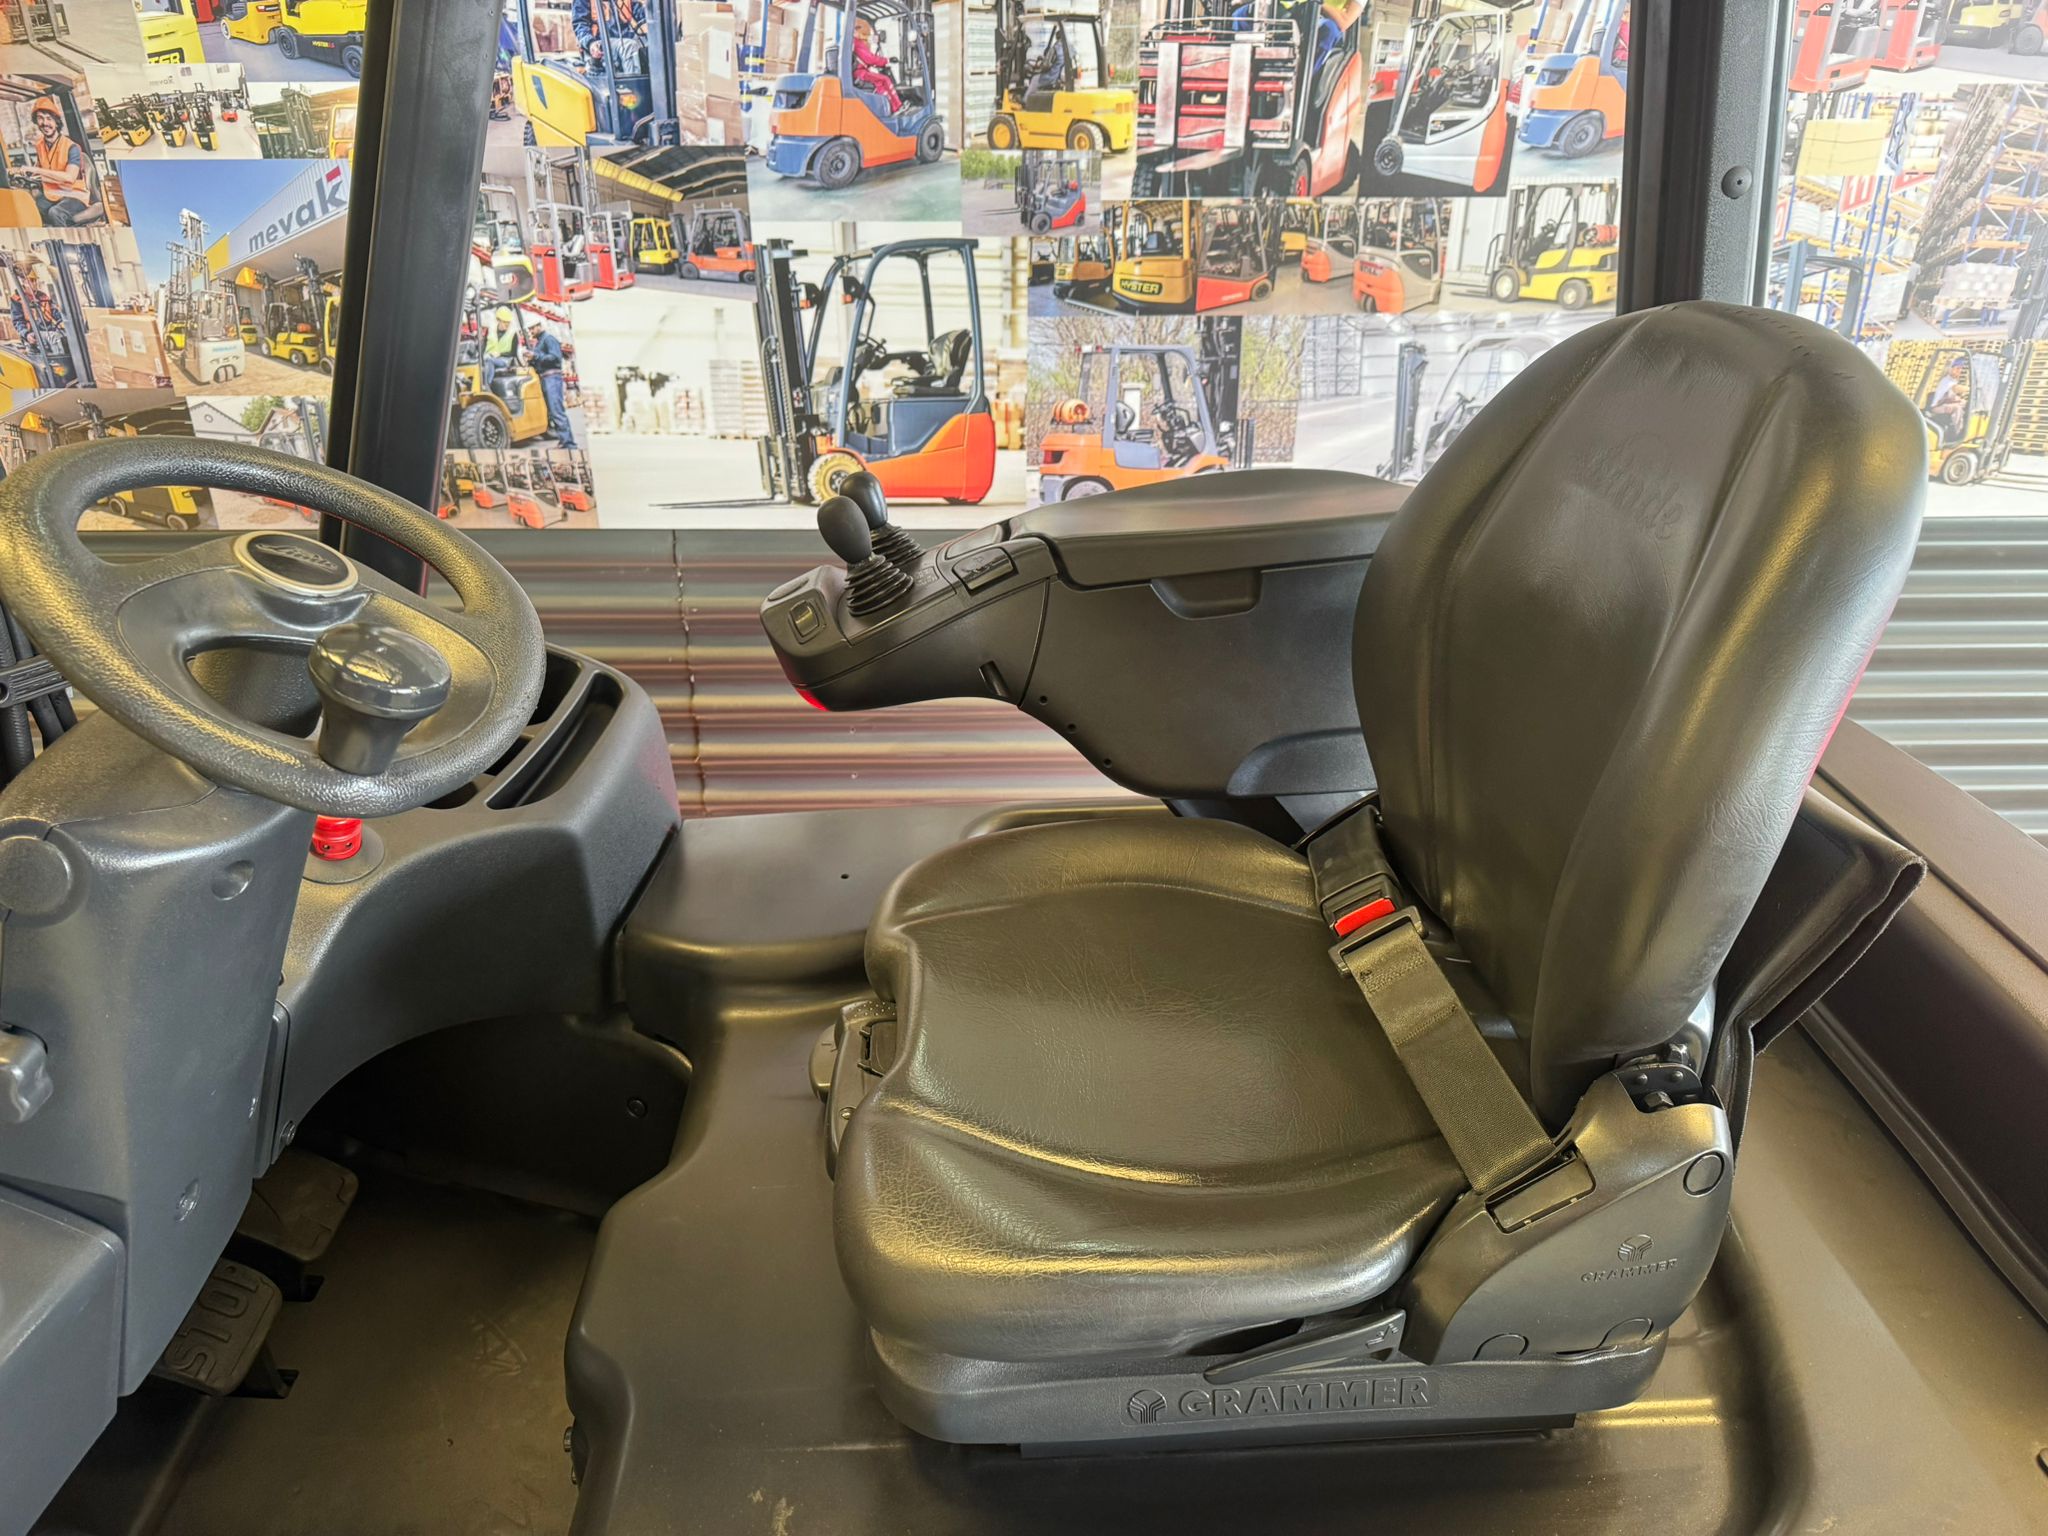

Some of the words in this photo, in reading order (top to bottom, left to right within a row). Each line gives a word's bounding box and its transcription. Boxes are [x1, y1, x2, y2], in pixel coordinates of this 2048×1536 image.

[249, 177, 347, 252] mevak
[1121, 280, 1160, 294] HYSTER
[1581, 1258, 1678, 1282] GRAMMER
[1179, 1377, 1429, 1417] GRAMMER
